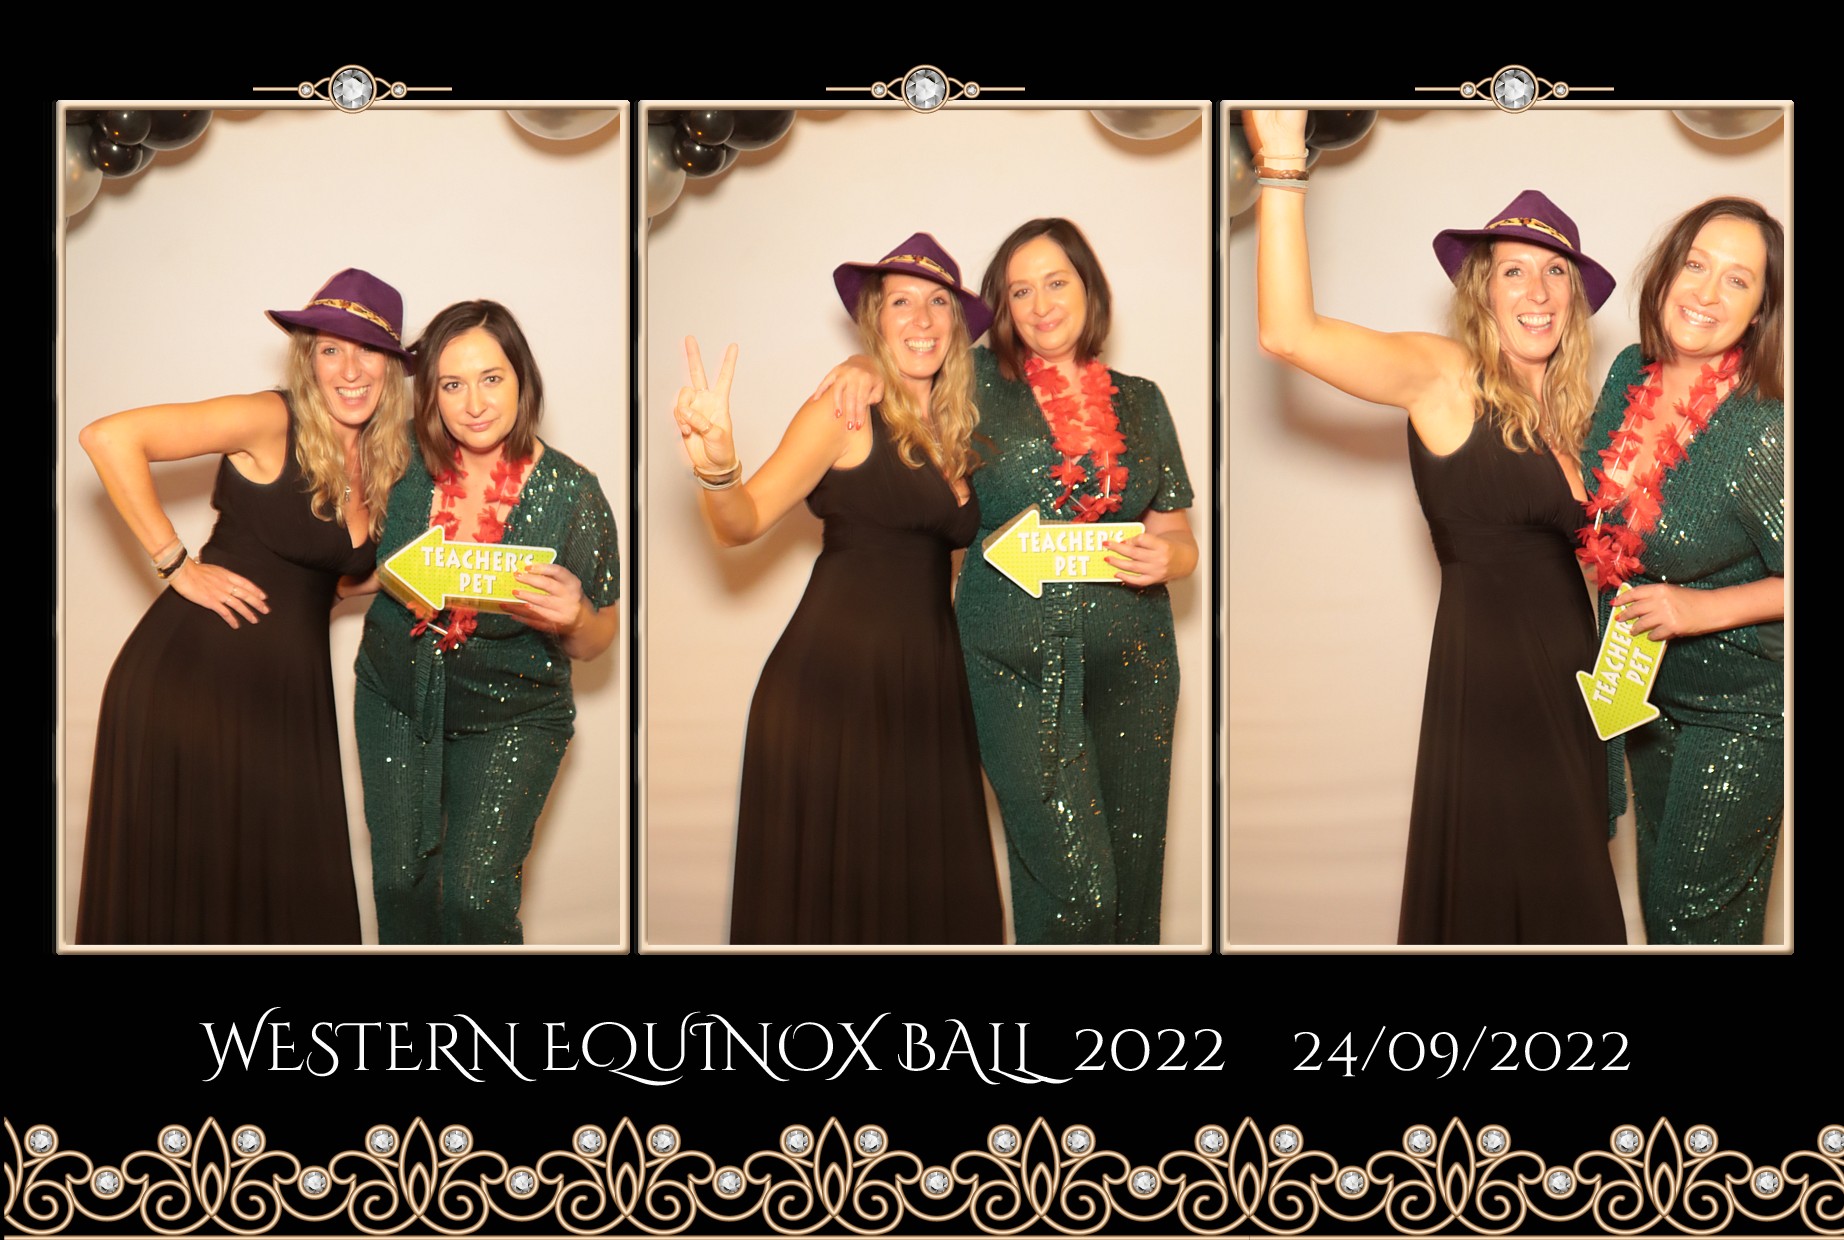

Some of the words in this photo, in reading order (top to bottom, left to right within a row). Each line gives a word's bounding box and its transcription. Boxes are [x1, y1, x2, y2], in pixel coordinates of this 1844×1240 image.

[1054, 555, 1090, 576] PET
[459, 572, 497, 595] PET
[1592, 604, 1637, 705] TEACHER
[1625, 646, 1654, 687] PET
